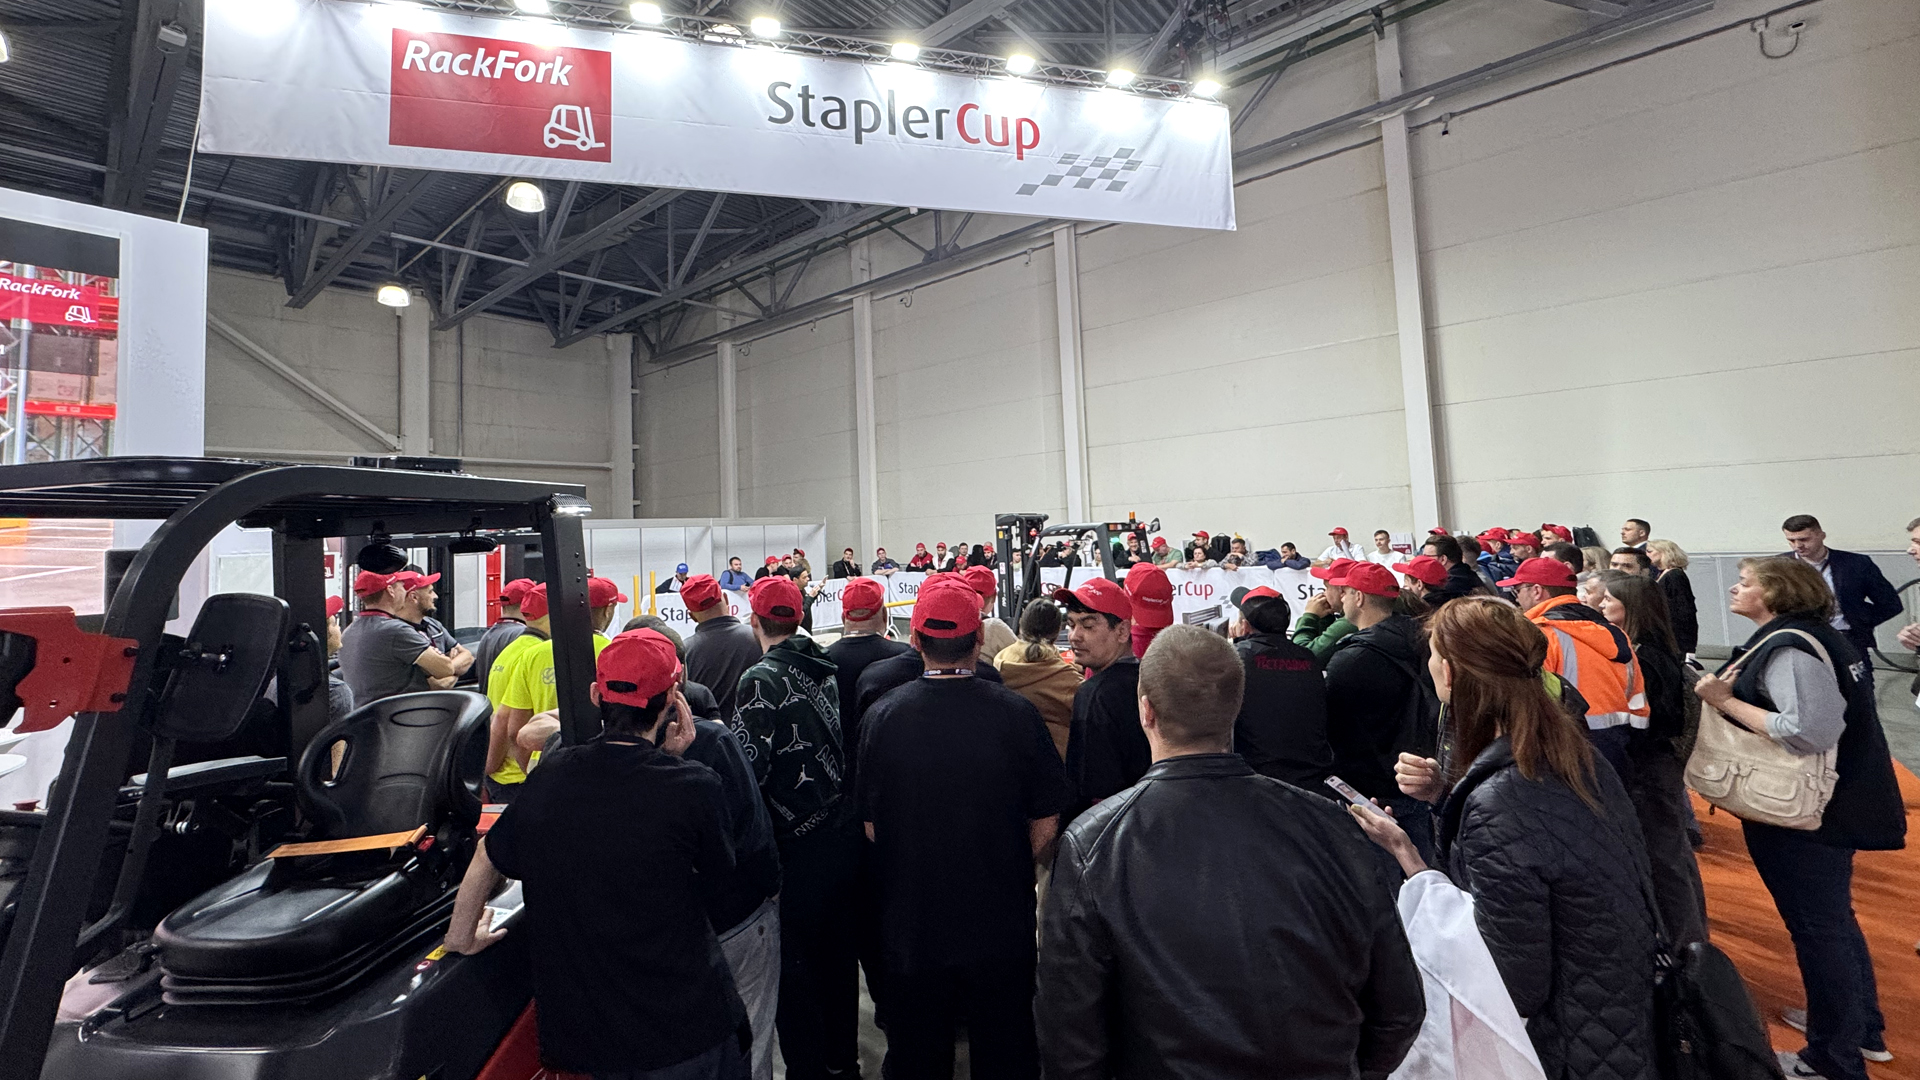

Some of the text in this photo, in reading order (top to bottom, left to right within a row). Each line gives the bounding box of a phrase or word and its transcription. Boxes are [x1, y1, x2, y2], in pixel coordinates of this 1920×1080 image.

[402, 40, 573, 86] RackFork
[767, 81, 1040, 160] StaplerCup
[0, 278, 81, 300] RackFork
